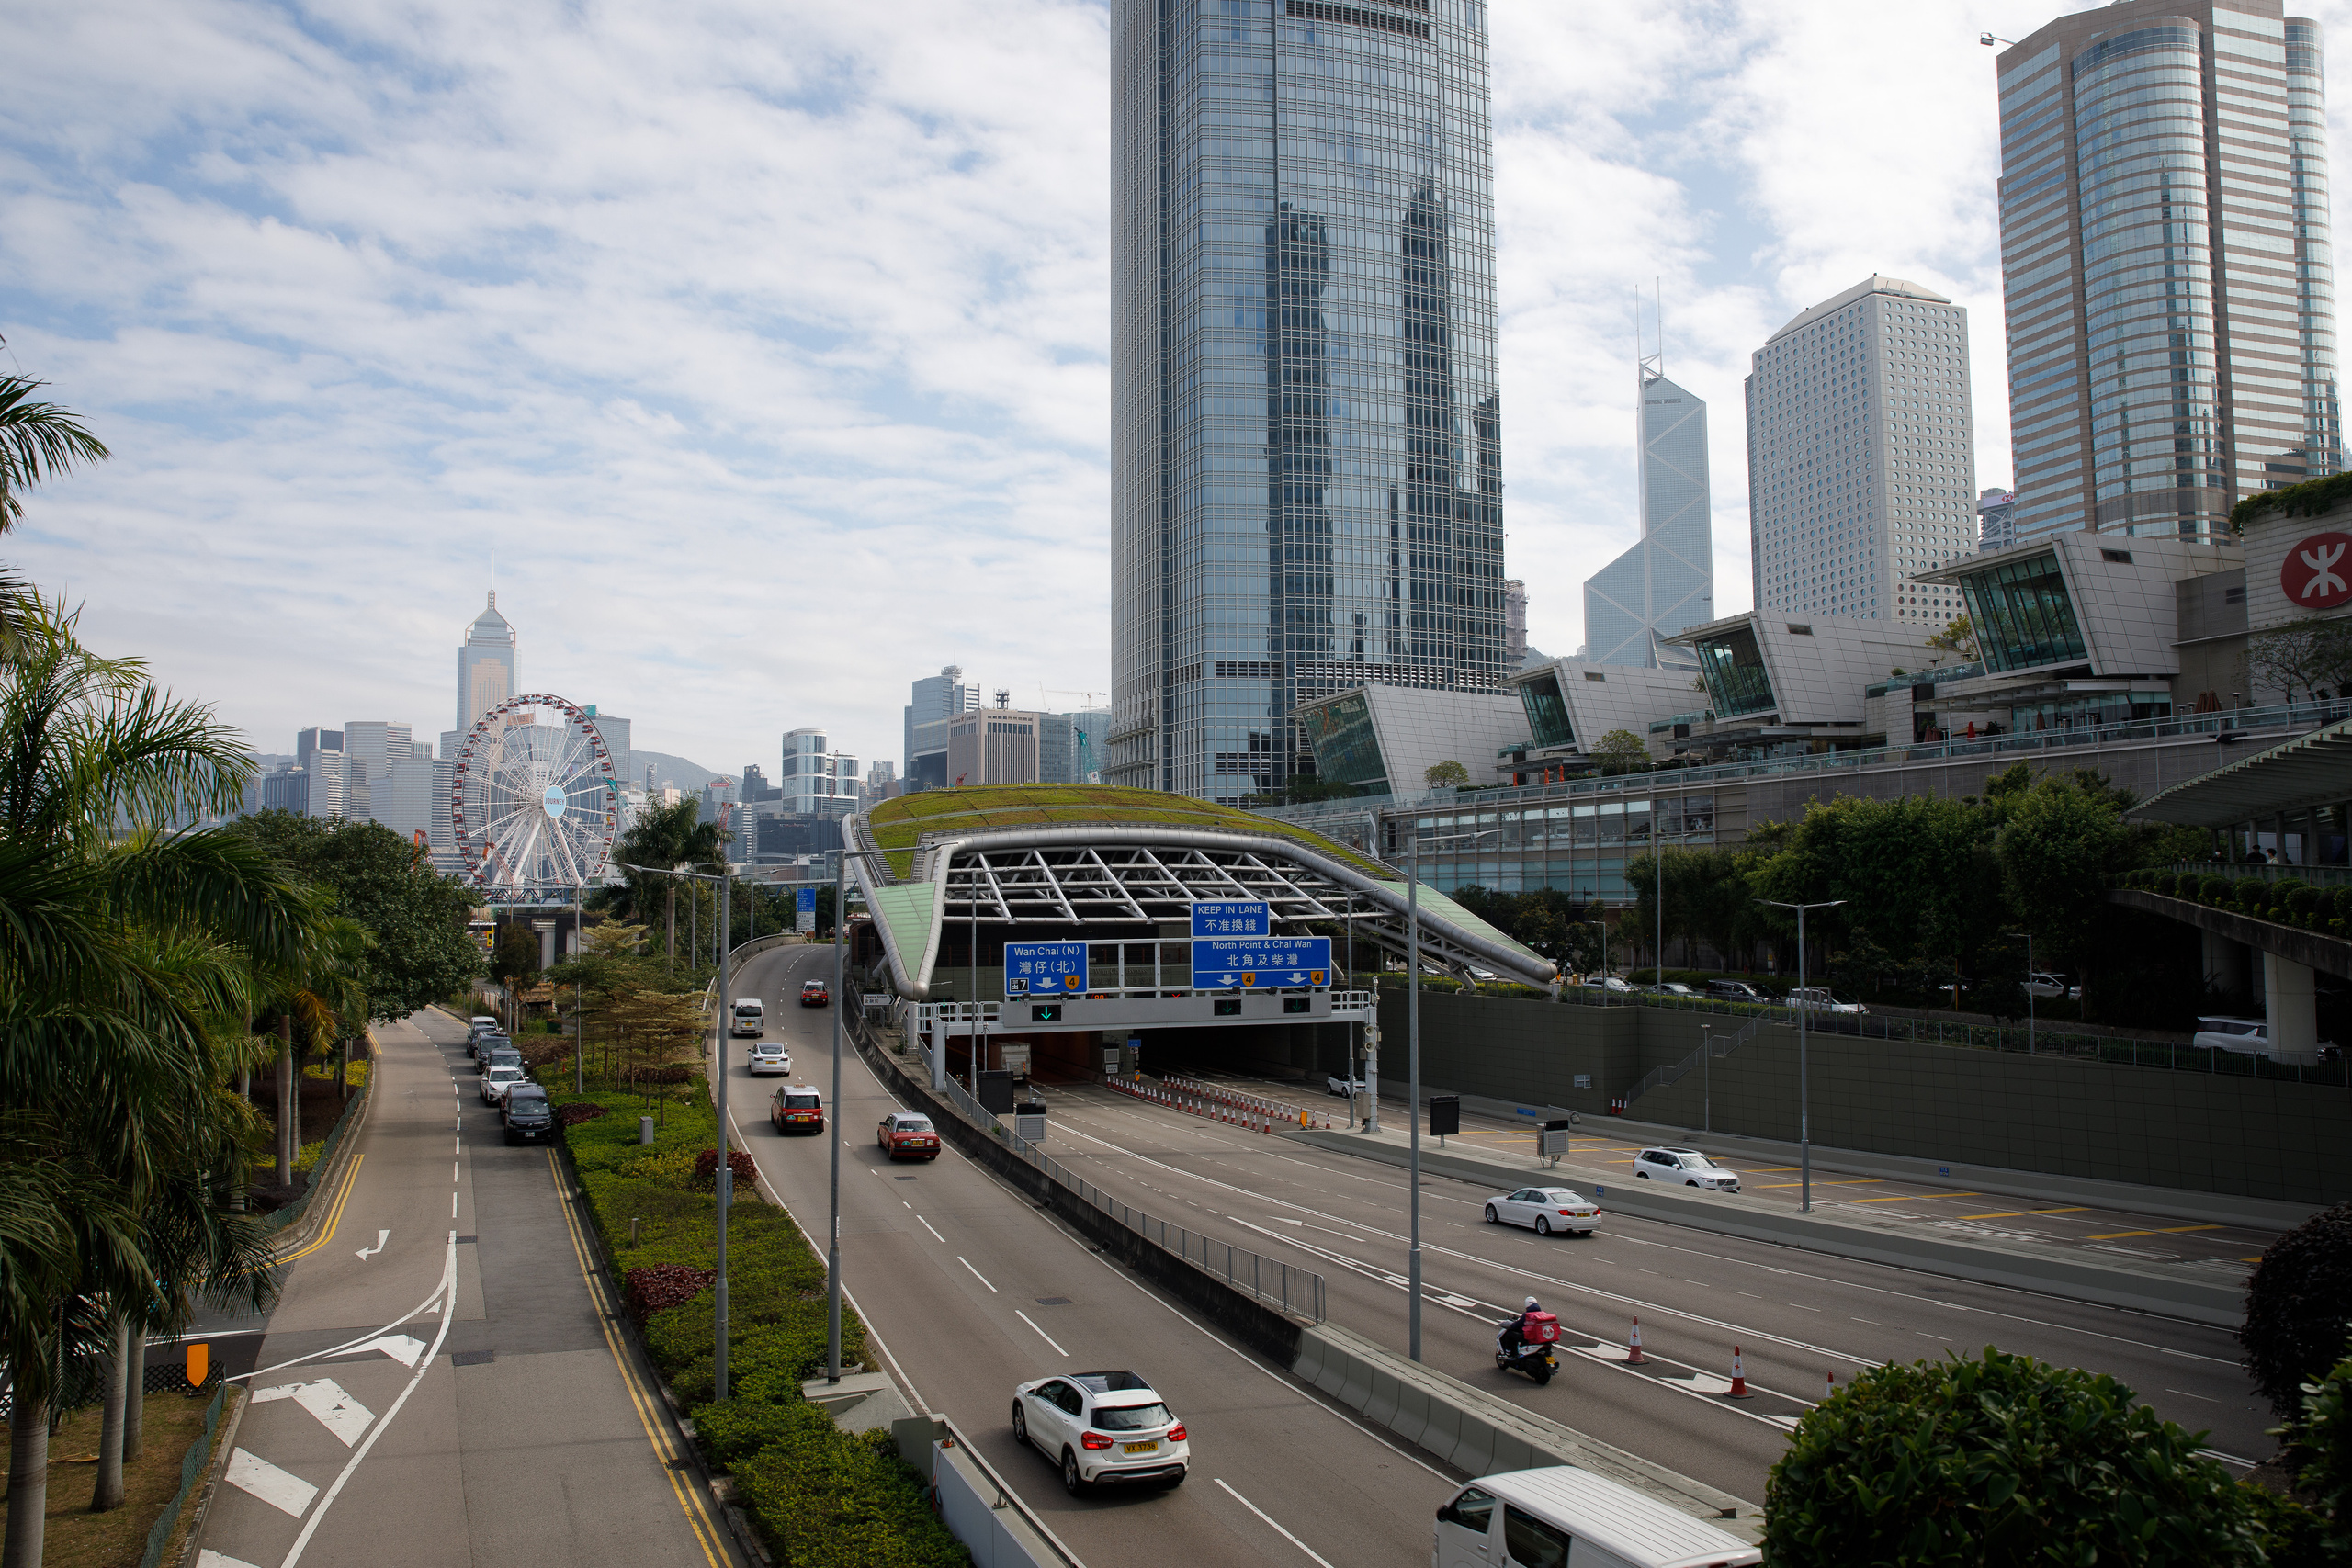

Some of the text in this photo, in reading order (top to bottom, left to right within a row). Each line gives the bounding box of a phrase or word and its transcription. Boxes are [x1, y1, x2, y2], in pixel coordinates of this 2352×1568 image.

[1198, 905, 1263, 914] KEEP IN LANE
[1212, 940, 1312, 950] North Point & Chai Wan
[1013, 945, 1080, 956] Wan Chai (N)
[1227, 953, 1298, 966] 北角及柴灣
[1019, 961, 1076, 974] 灣仔(北)
[1069, 977, 1076, 986] 4
[1246, 975, 1252, 983] 4
[1314, 974, 1320, 982] 4
[1020, 979, 1026, 990] 7
[1137, 1442, 1156, 1451] 3738
